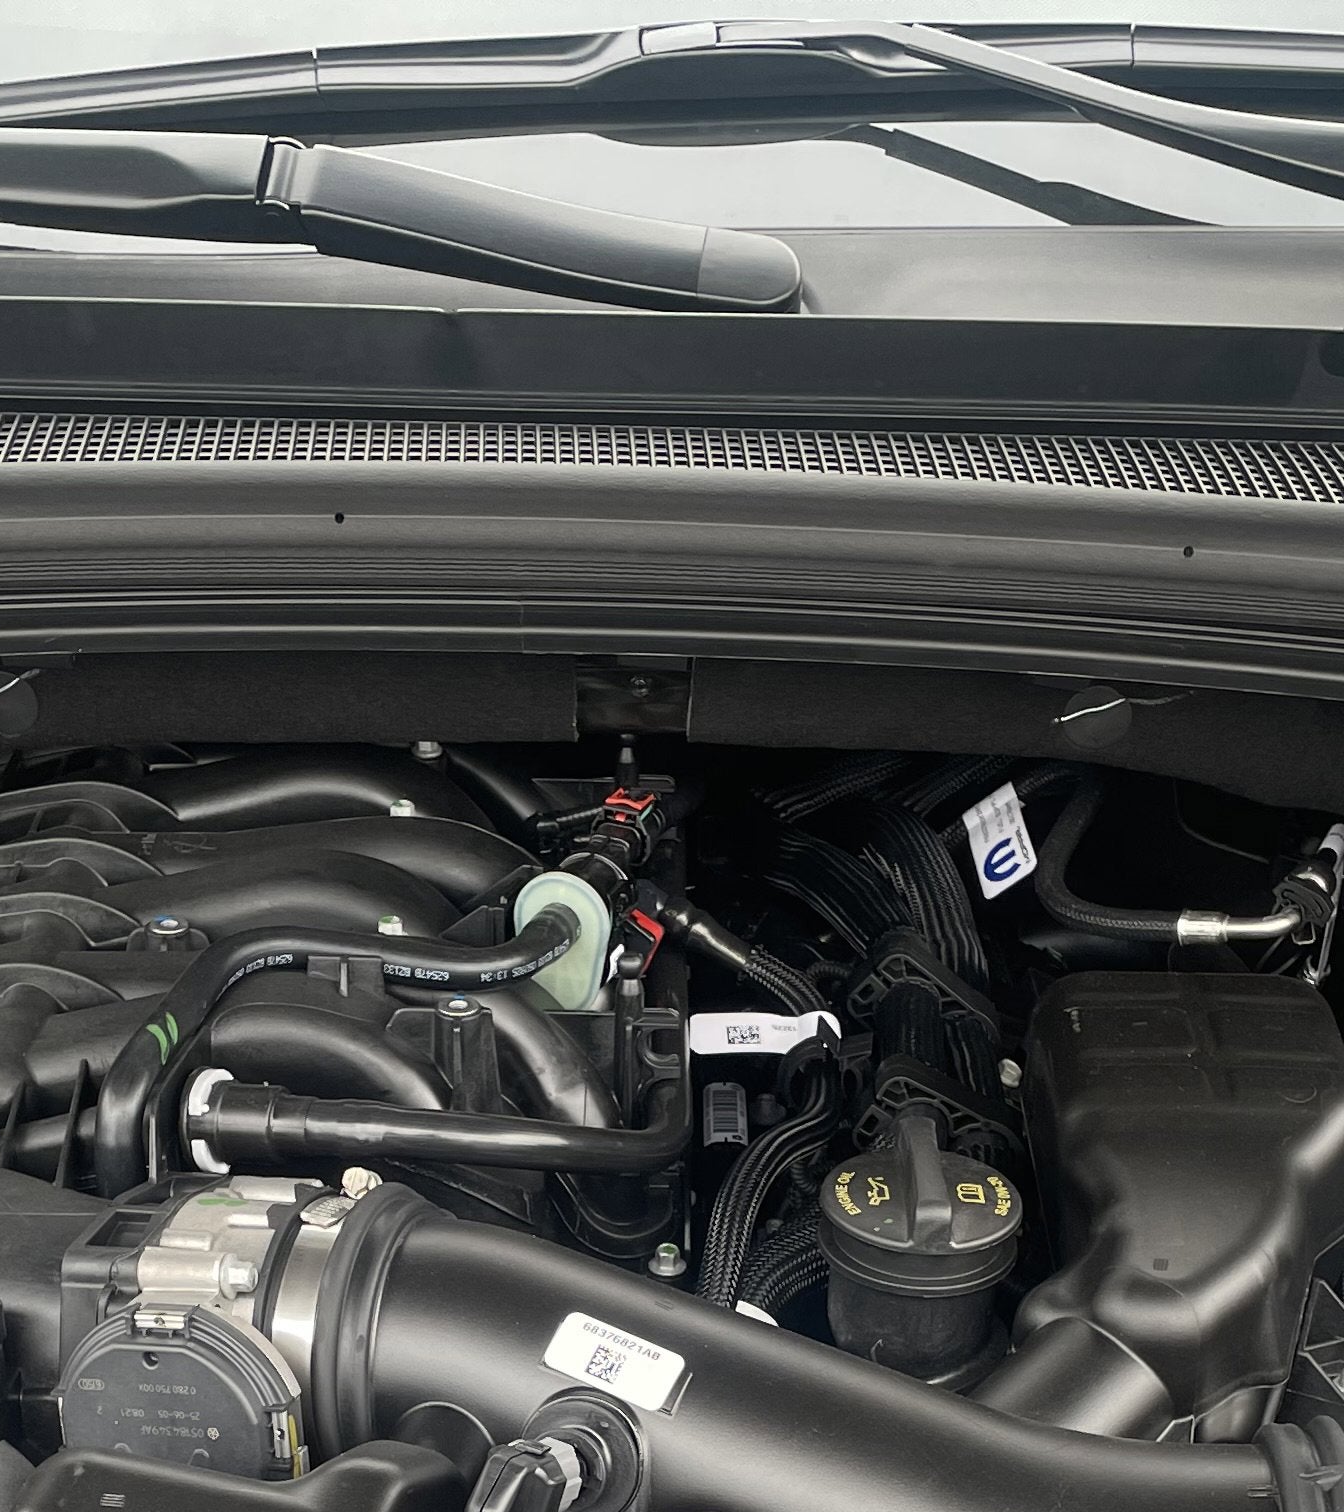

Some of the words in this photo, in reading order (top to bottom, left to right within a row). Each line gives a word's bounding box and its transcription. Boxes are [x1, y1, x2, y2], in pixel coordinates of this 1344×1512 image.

[837, 1171, 856, 1185] OIL
[835, 1184, 862, 1216] ENGINE
[582, 1322, 662, 1361] 68376821AB
